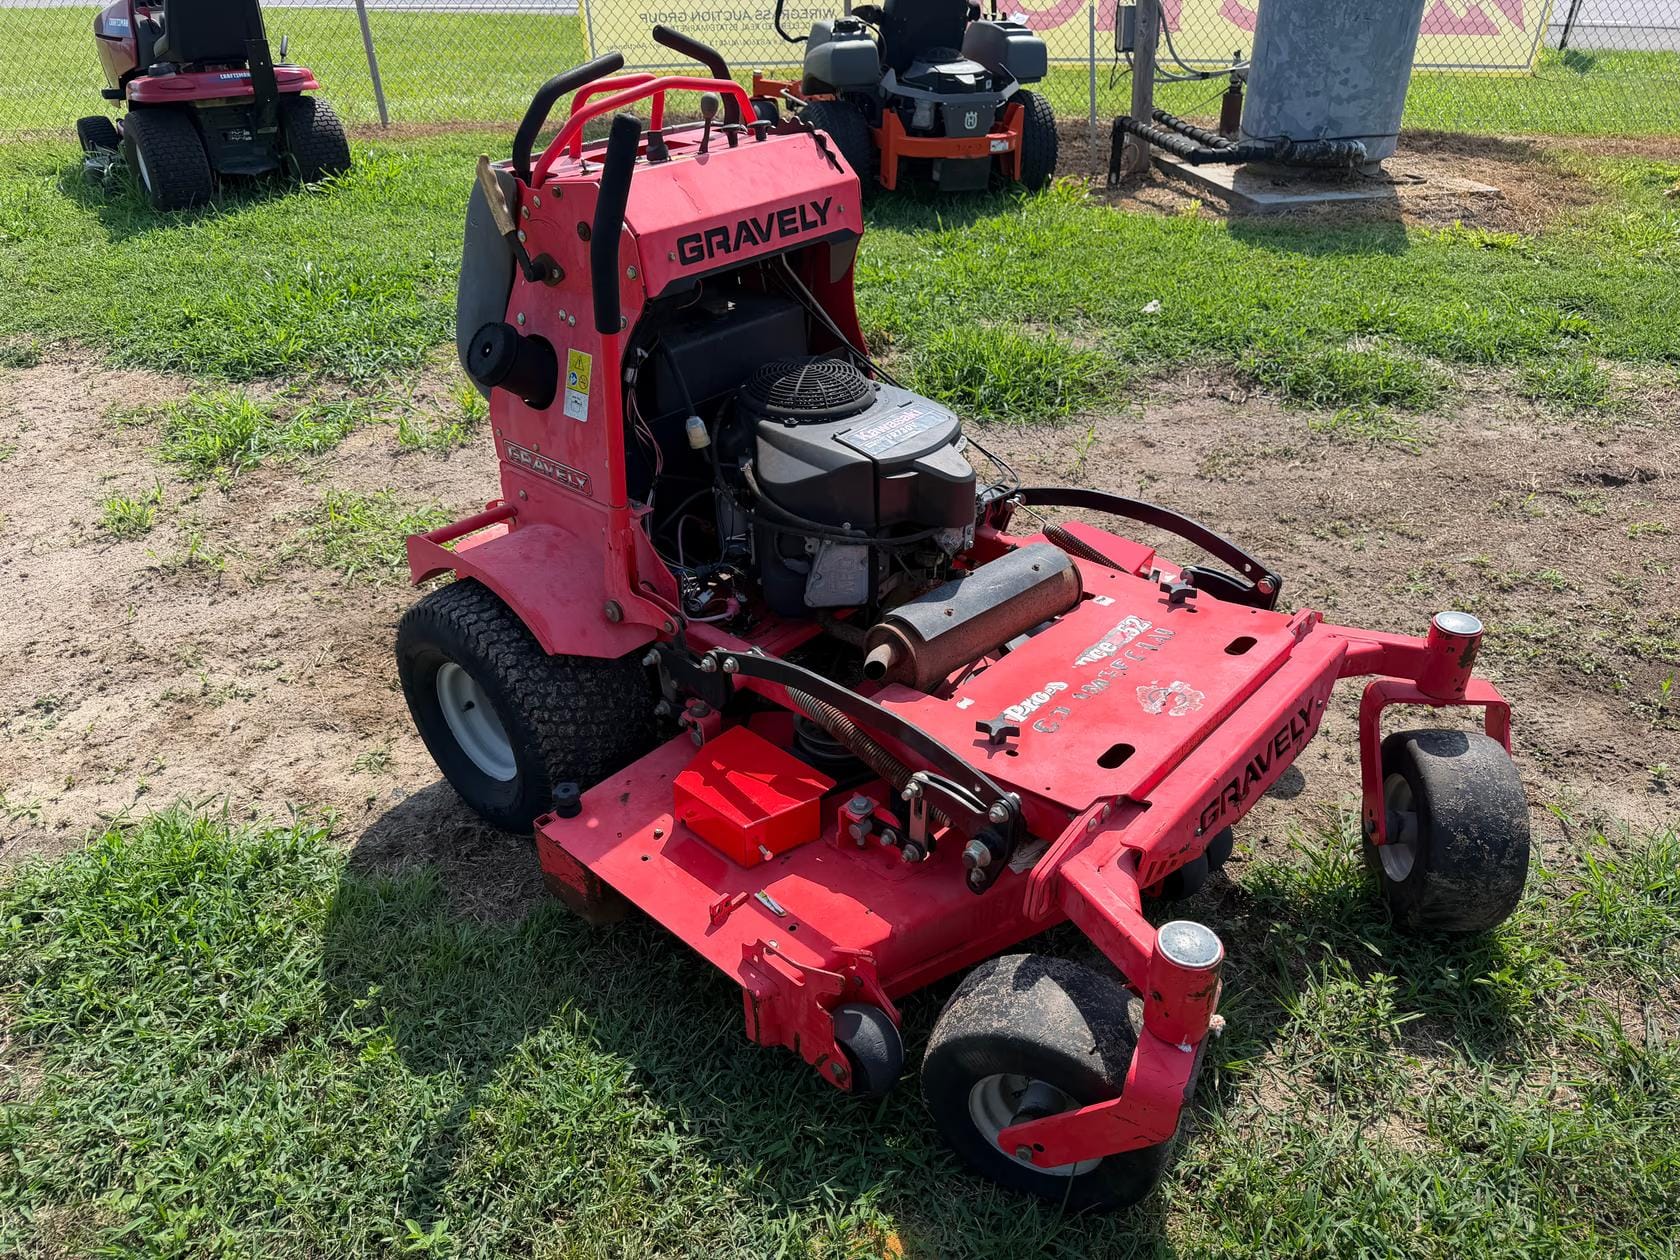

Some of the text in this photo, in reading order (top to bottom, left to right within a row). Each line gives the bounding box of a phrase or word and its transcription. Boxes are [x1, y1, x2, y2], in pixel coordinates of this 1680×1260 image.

[676, 196, 832, 266] GRAVELY
[856, 408, 923, 441] Kawasaki
[507, 445, 587, 489] GRAVELY
[1200, 696, 1315, 834] GRAVELY
